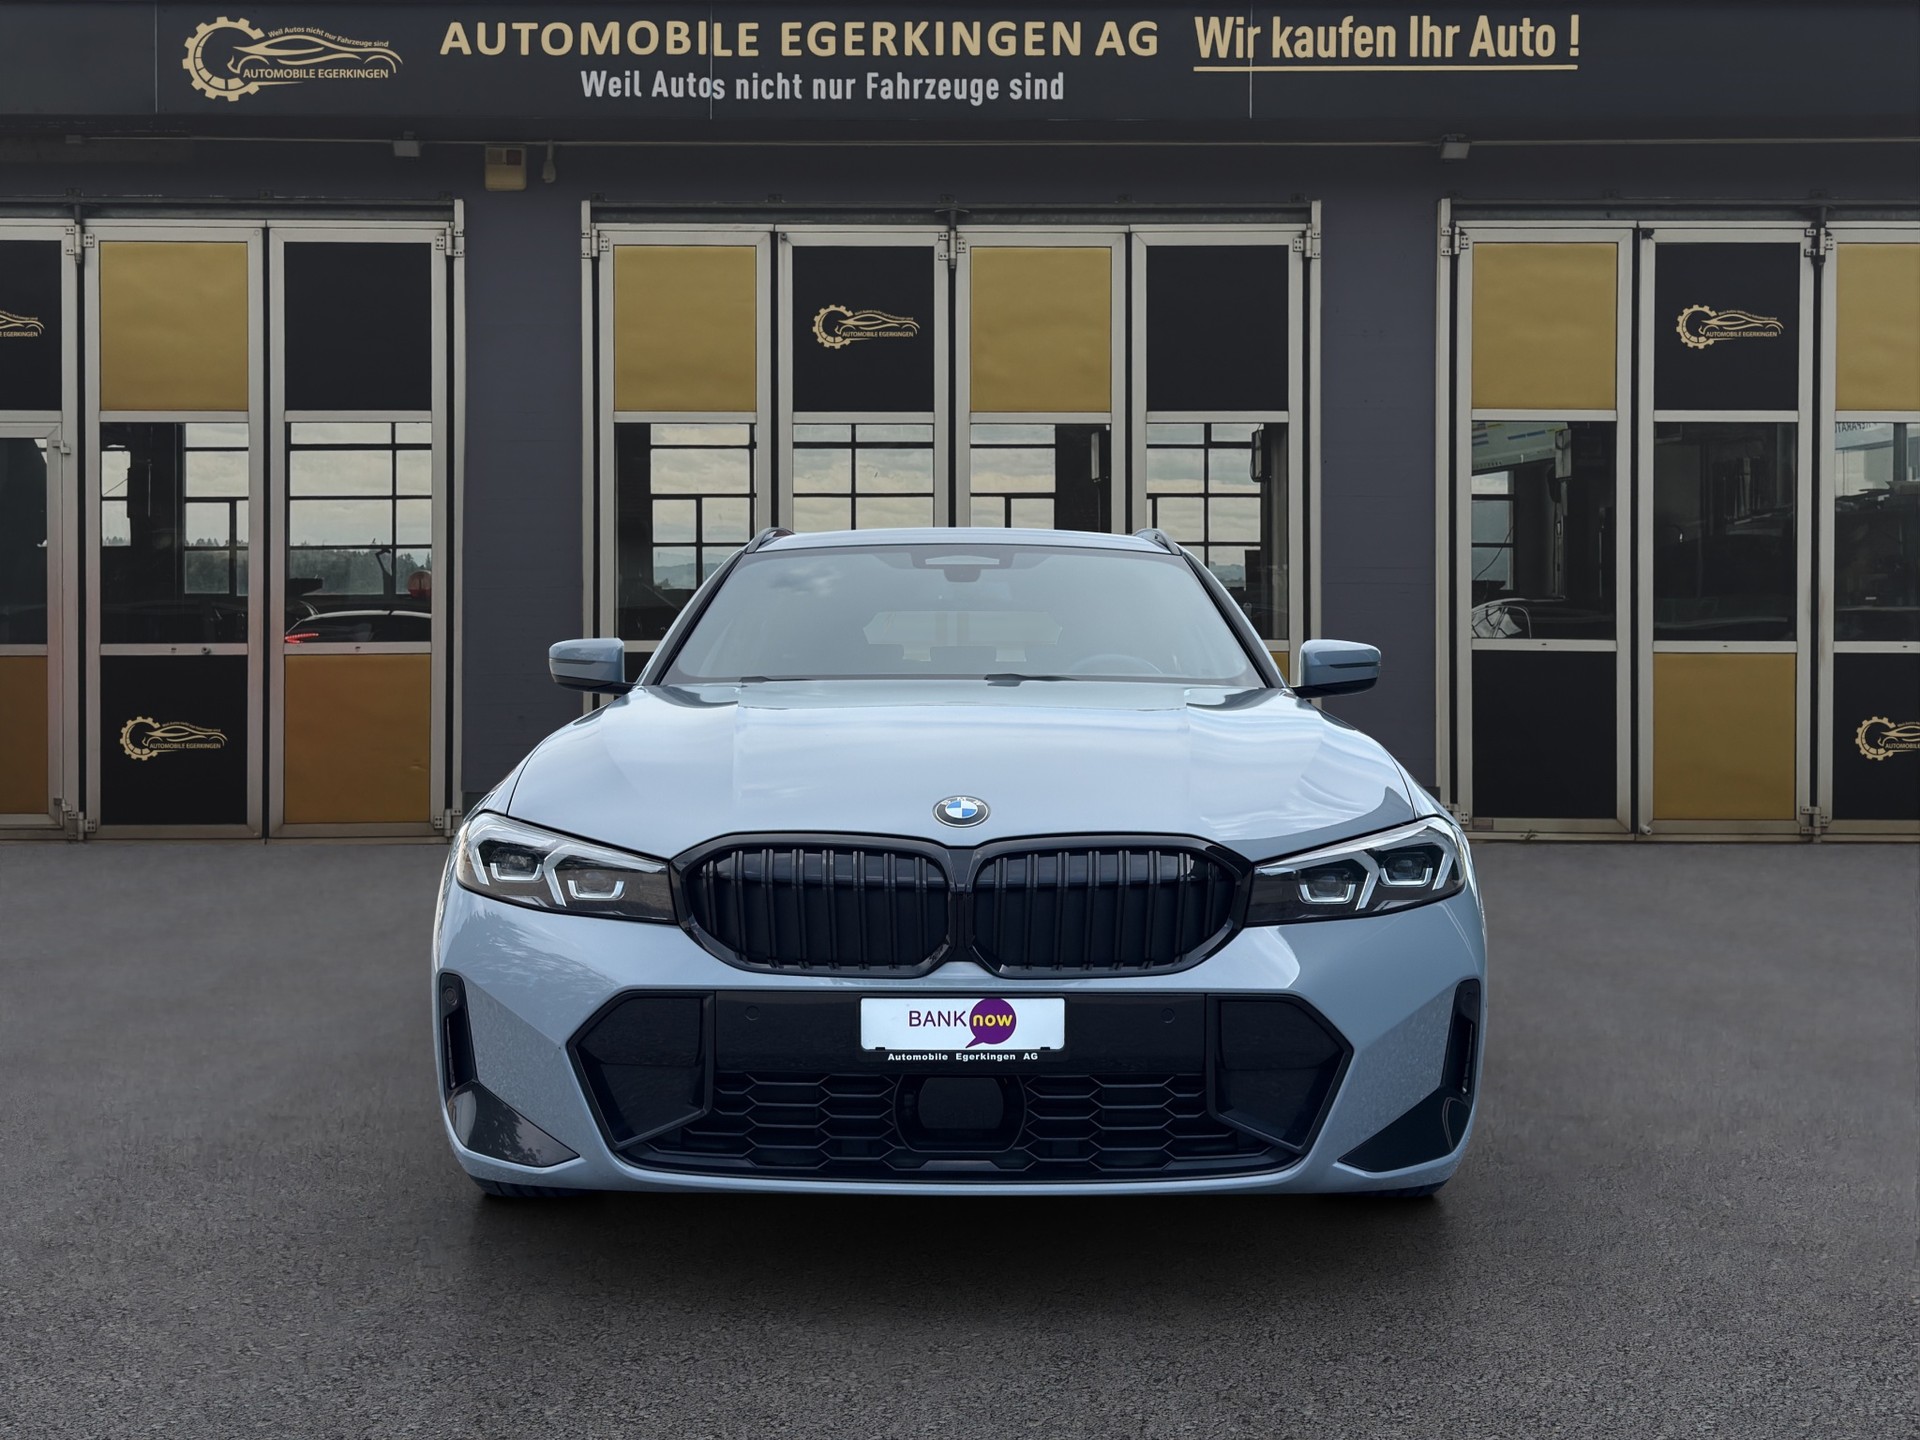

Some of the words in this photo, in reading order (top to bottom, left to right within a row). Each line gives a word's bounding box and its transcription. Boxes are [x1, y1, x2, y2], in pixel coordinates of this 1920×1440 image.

[267, 28, 283, 38] Weil
[284, 26, 305, 34] Autos
[305, 26, 324, 36] nicht
[324, 32, 337, 40] nur
[336, 35, 372, 48] Fahrzeuge
[439, 20, 759, 57] AUTOMOBILE
[781, 20, 1082, 57] EGERKINGEN
[1094, 20, 1159, 57] AG
[1194, 15, 1261, 59] Wir
[1271, 15, 1396, 59] kaufen
[1409, 15, 1460, 58] Ihr
[1469, 14, 1556, 58] Auto
[1569, 14, 1580, 57] !
[243, 68, 316, 79] AUTOMOBILE
[318, 68, 389, 79] EGERKINGEN
[580, 70, 642, 98] Weil
[651, 70, 726, 100] Autos
[735, 72, 803, 100] nicht
[812, 76, 856, 100] nur
[866, 72, 1000, 107] Fahrzeuge
[1009, 71, 1064, 100] sind
[908, 1010, 967, 1027] BANK
[972, 1014, 1013, 1027] now
[887, 1053, 949, 1061] Automobile
[955, 1053, 1016, 1062] Egerkingen
[1023, 1053, 1038, 1061] AG
